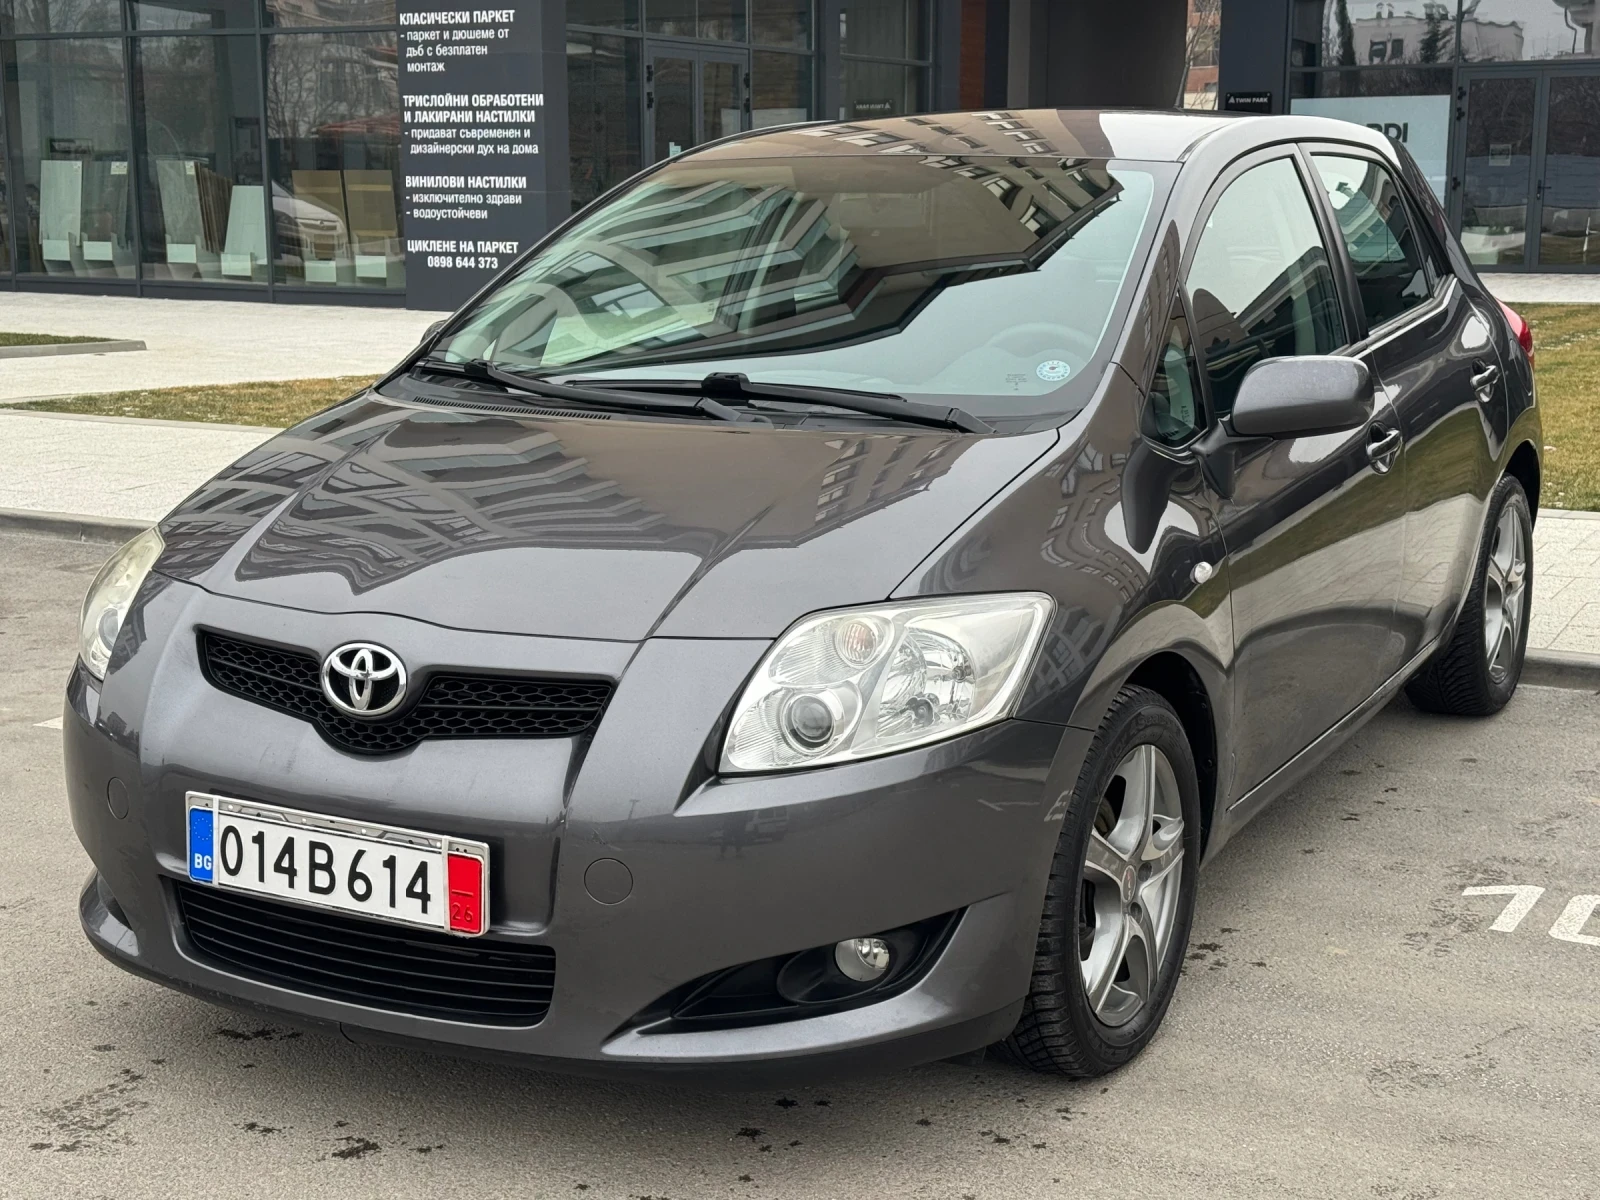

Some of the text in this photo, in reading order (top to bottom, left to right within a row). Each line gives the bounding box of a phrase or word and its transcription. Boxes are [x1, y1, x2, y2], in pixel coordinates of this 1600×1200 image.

[399, 9, 516, 26] КЛАСИЧЕСКИ ПАРКЕТ
[406, 30, 441, 43] паркет
[442, 30, 450, 41] и
[451, 28, 496, 41] дюшеме
[497, 27, 510, 39] от
[405, 44, 488, 58] дъб с безплатен
[406, 61, 446, 73] монтаж
[402, 92, 544, 108] ТРИСЛОЙНИ ОБРАБОТЕНИ
[403, 109, 536, 124] И ЛАКИРАНИ НАСТИЛКИ
[410, 128, 457, 141] придават
[459, 128, 522, 141] съвременен
[523, 128, 531, 139] и
[409, 141, 539, 157] дизайнерски дух на дома
[405, 175, 527, 189] ВИНИЛОВИ НАСТИЛКИ
[412, 193, 484, 205] изключително
[485, 193, 523, 207] здрави
[412, 206, 488, 221] водоустойчеви
[406, 239, 519, 254] ЦИКЛЕНЕ НА ПАРКЕТ
[427, 255, 499, 270] 0898 644 373
[193, 852, 212, 871] BG
[220, 825, 431, 914] 014B614
[452, 901, 474, 923] 26
